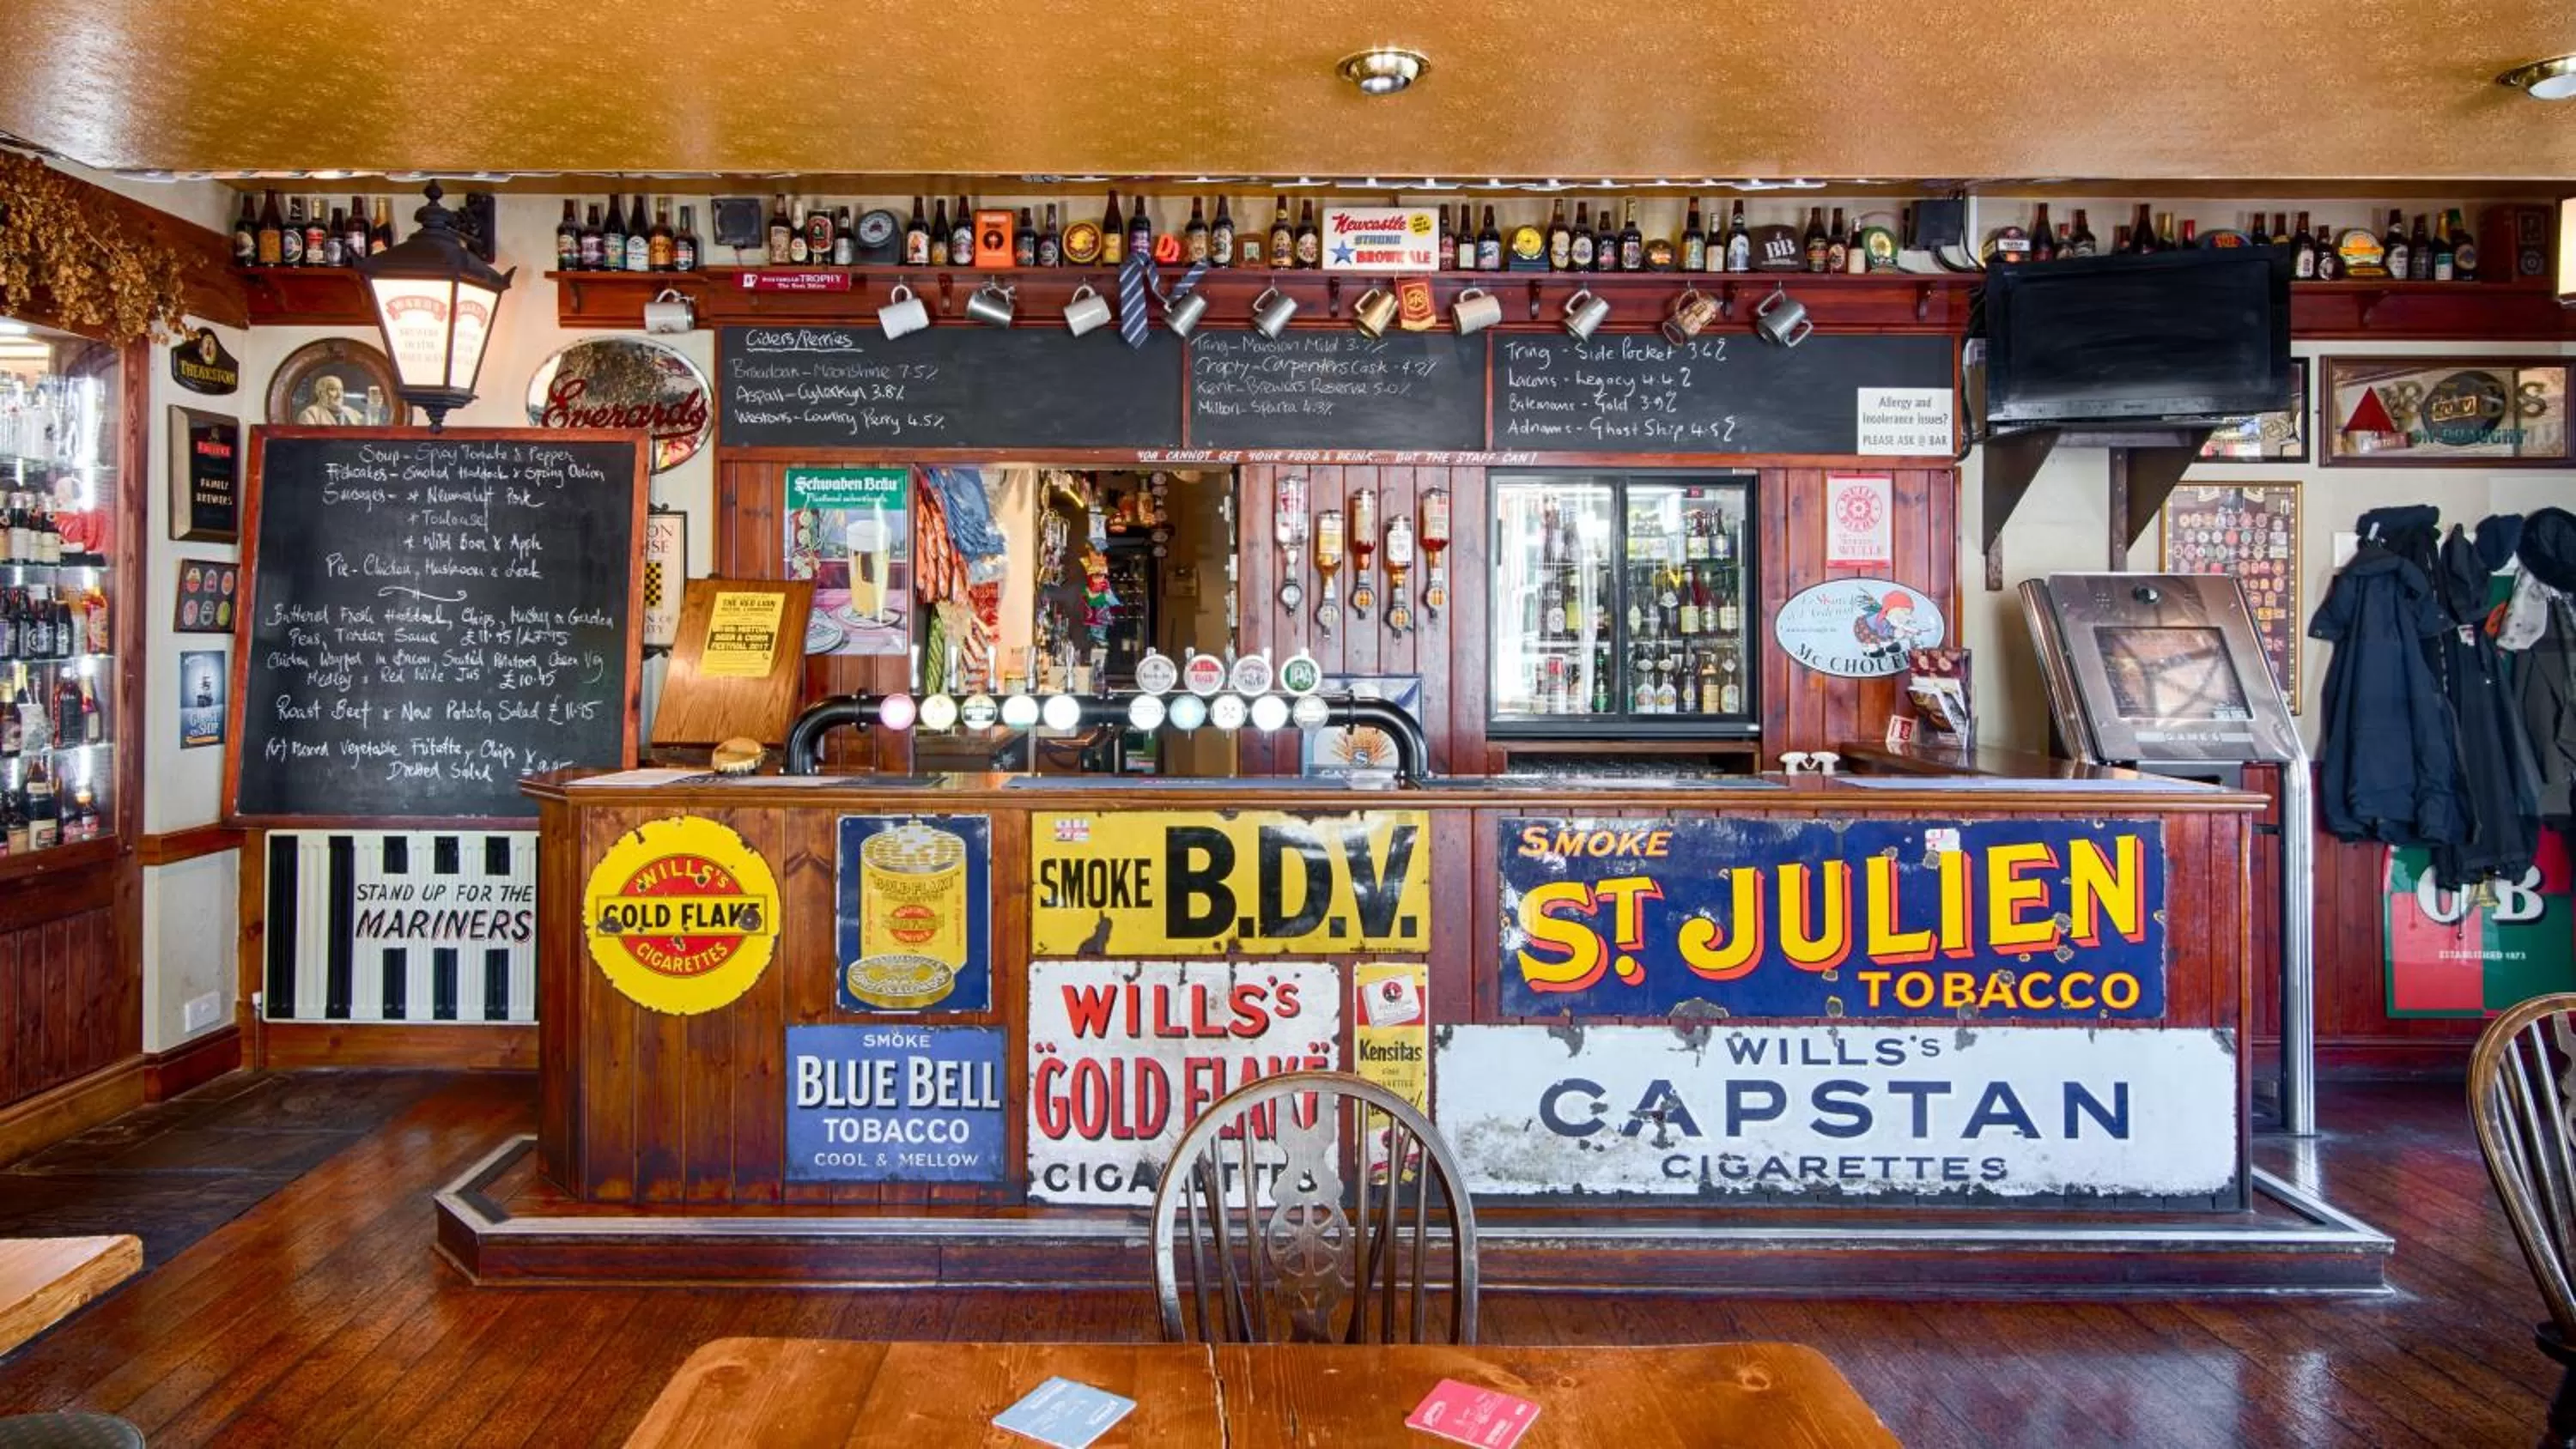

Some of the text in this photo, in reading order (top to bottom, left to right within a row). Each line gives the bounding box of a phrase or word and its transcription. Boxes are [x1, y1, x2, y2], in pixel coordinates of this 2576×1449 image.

[1333, 213, 1406, 233] Newcastle
[799, 274, 841, 282] TROPHY
[1304, 334, 1339, 351] Mild
[1506, 342, 1552, 370] Tring
[1575, 342, 1616, 361] Side
[1621, 336, 1676, 361] Pocket
[1575, 370, 1636, 397] Legacy
[541, 369, 708, 432] Everards
[1594, 391, 1629, 413] Gold
[1879, 396, 1933, 409] Allergy and
[804, 408, 858, 435] Country
[860, 407, 901, 435] Perry
[1507, 417, 1572, 436] Adnams
[1589, 415, 1640, 440] Ghost
[1644, 417, 1684, 442] Ship
[1862, 412, 1915, 425] Intolerance
[1862, 434, 1894, 446] PLEASE
[1898, 435, 1915, 445] ASK
[1929, 435, 1948, 446] BAR
[358, 443, 399, 468] Soup
[529, 446, 574, 469] Pepper
[1165, 451, 1213, 460] CANNOT
[1218, 451, 1242, 461] GET
[1249, 452, 1283, 461] YOUR
[1395, 452, 1419, 462] BUT
[1425, 452, 1449, 463] THE
[1456, 452, 1495, 463] STAFF
[325, 552, 349, 578] Pie
[380, 667, 405, 684] Red
[276, 694, 323, 722] Roast
[330, 697, 373, 728] Beef
[400, 700, 434, 721] New
[497, 698, 540, 722] Salad
[1518, 827, 1674, 858] SMOKE
[356, 883, 534, 902] STAND UP FOR THE
[1040, 825, 1419, 939] SMOKE B.D.V.
[603, 903, 671, 929] GOLD
[1678, 834, 2147, 980] JULIEN
[355, 908, 532, 943] MARINERS
[636, 942, 729, 973] CIGARETTES
[2438, 949, 2502, 960] ESTABLISHED
[1858, 970, 2142, 1011] TOBACCO
[863, 1033, 932, 1048] SMOKE
[1359, 1040, 1423, 1063] Kensitas
[796, 1055, 1003, 1110] BLUE BELL
[1539, 1078, 2134, 1141] CAPSTAN
[823, 1118, 970, 1144] TOBACCO
[815, 1152, 980, 1167] COOL & MELLOW
[1661, 1155, 2009, 1182] CIGARETTES
